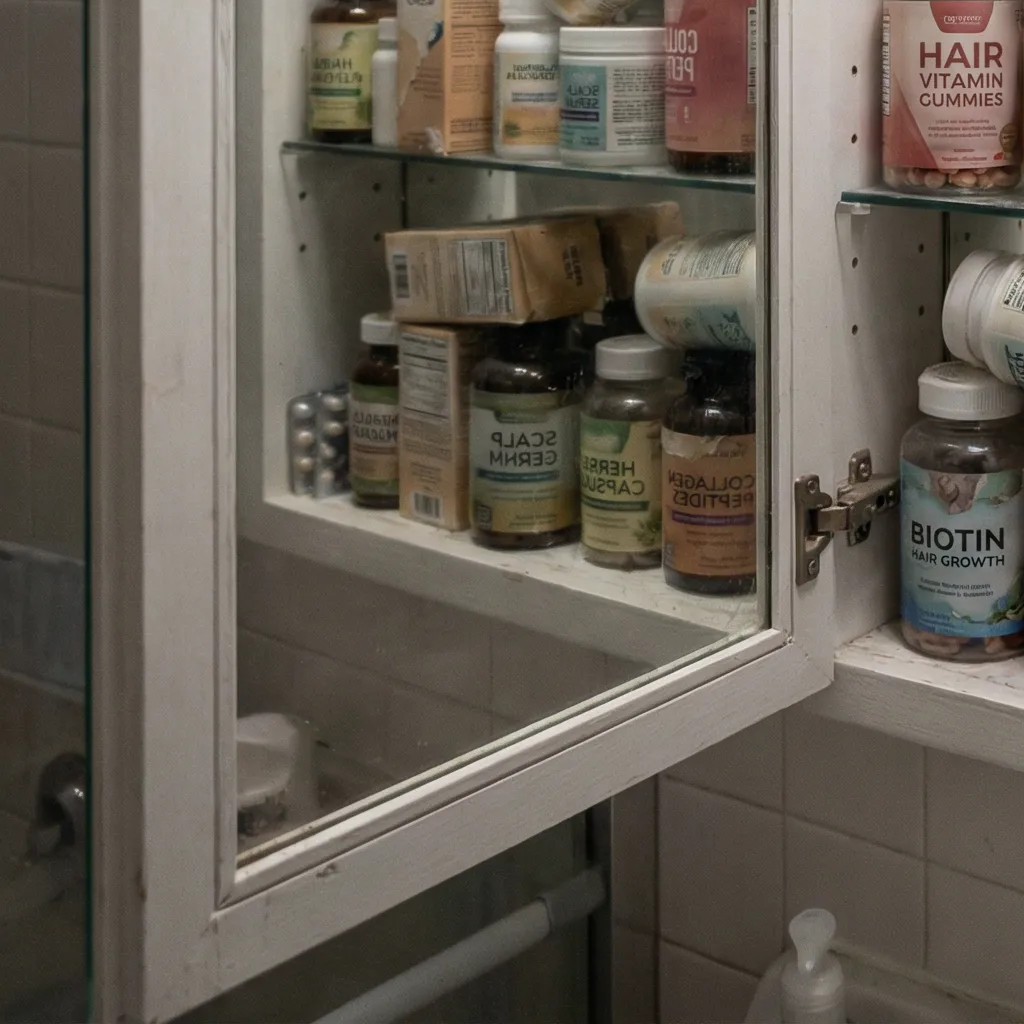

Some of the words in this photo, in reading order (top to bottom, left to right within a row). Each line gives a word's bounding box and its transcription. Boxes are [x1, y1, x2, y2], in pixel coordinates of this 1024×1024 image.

[919, 41, 1003, 69] HAIR
[919, 73, 1003, 89] VITAMIN
[919, 92, 1003, 108] GUMMIES
[911, 520, 1004, 552] BIOTIN
[911, 549, 937, 565] HAIR
[940, 555, 1005, 568] GROWTH
